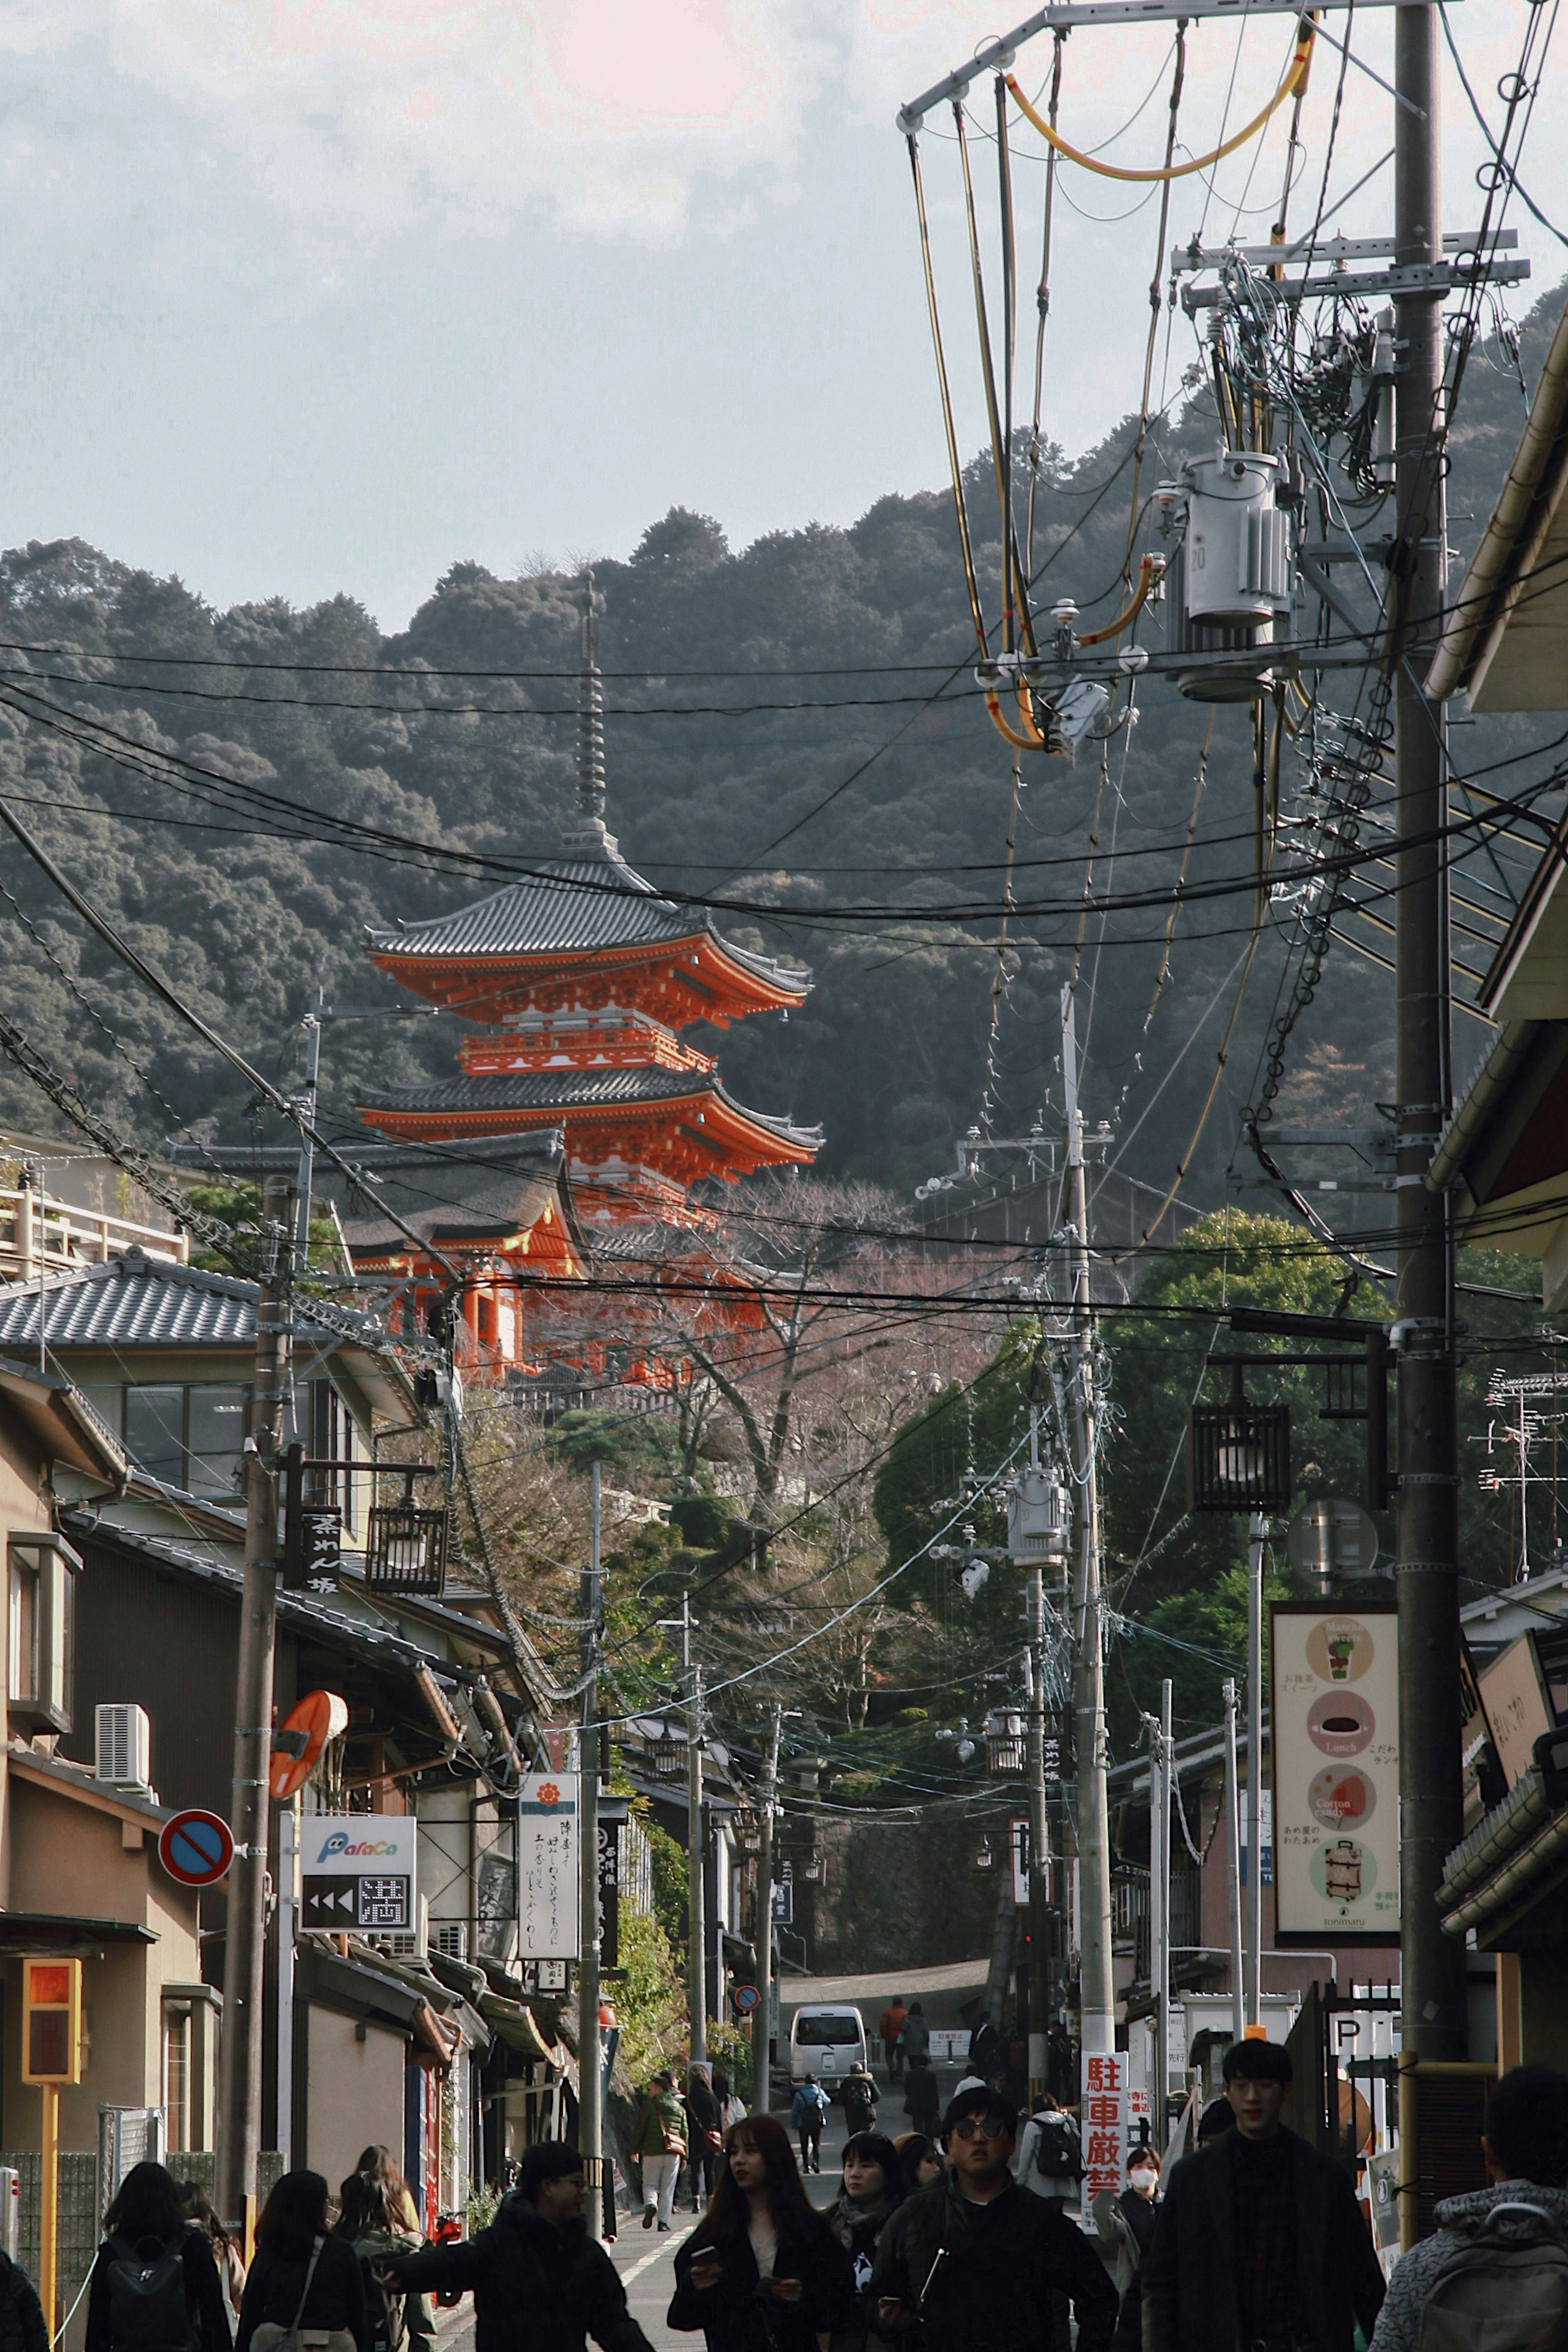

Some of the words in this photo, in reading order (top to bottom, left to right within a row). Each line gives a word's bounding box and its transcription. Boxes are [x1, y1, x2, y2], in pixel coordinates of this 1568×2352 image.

[307, 1516, 340, 1593] 茶わん坂
[1326, 1622, 1364, 1631] Matcha
[1043, 1738, 1061, 1781] 茶わん坂
[1326, 1742, 1356, 1752] Lunch
[1314, 1808, 1343, 1818] candy
[1316, 1798, 1351, 1808] Cotton
[362, 1880, 404, 1923] 満
[1086, 2057, 1121, 2202] 駐車厳禁
